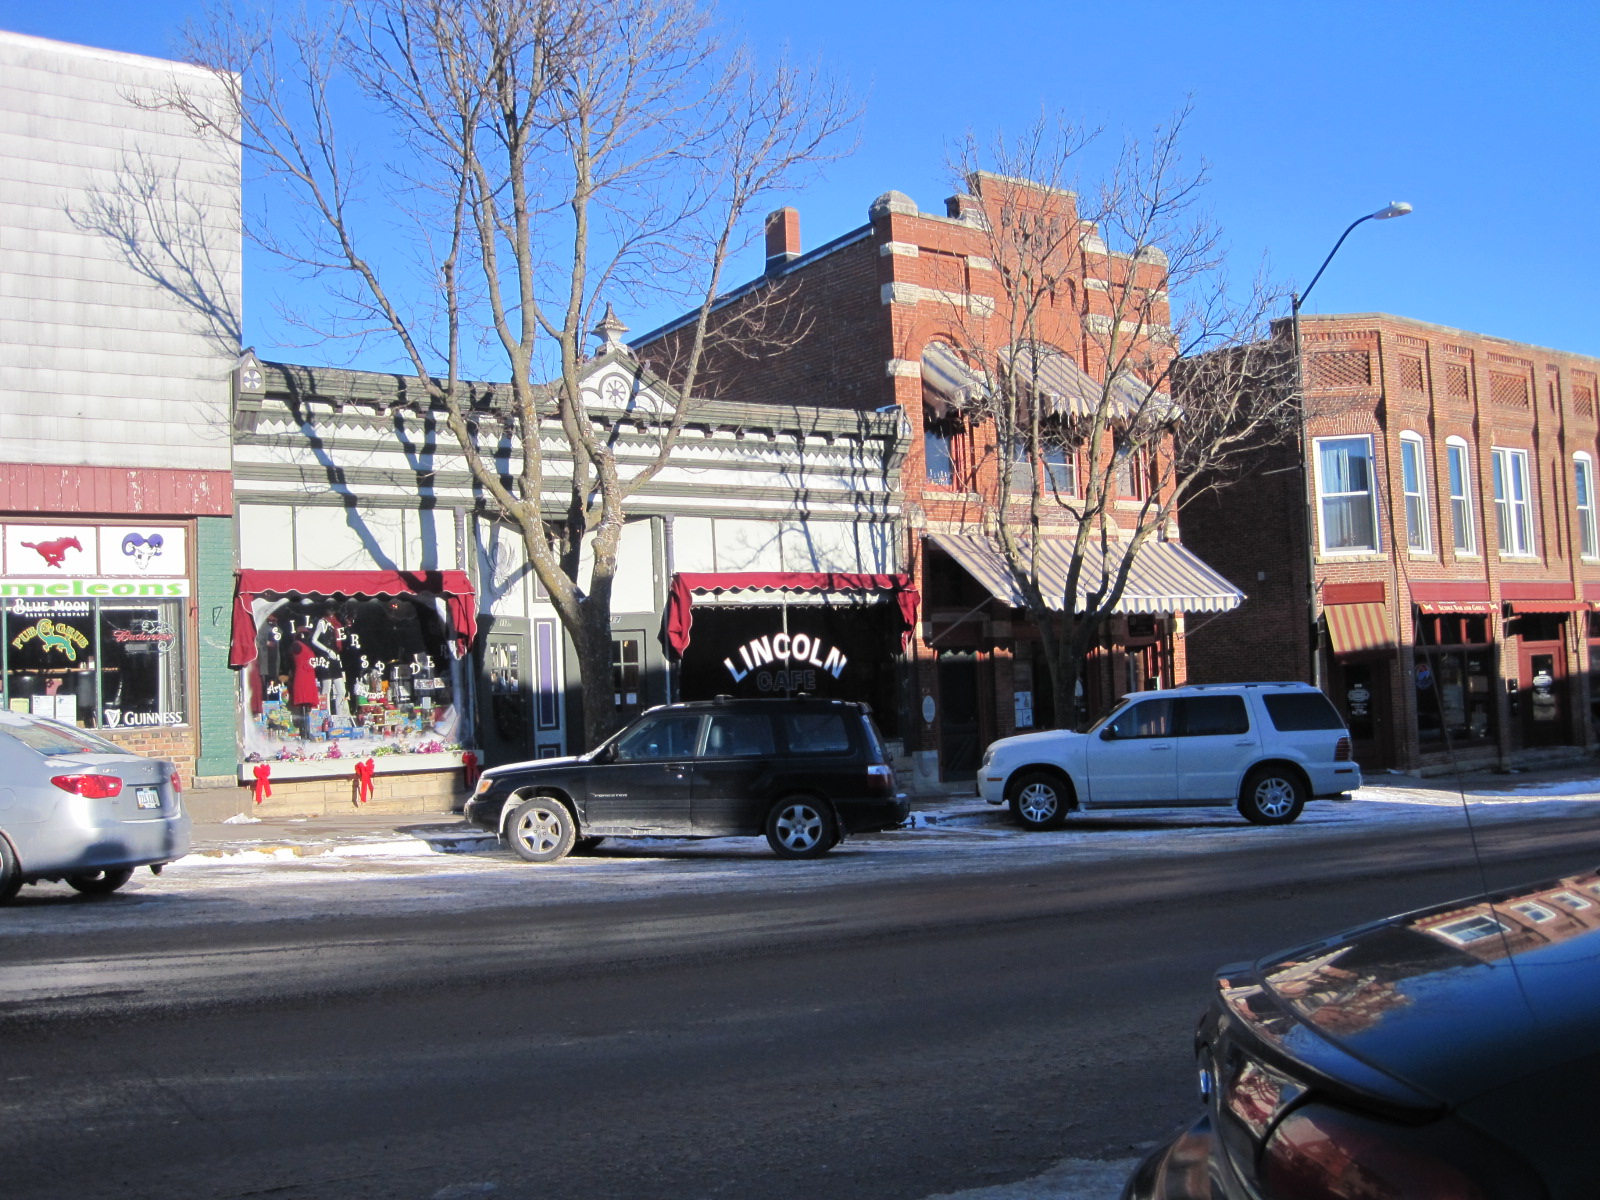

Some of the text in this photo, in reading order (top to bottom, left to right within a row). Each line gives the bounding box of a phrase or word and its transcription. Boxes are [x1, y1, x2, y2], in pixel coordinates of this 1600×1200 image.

[12, 598, 90, 614] BLUE MOON
[12, 626, 38, 650] PUB
[55, 623, 89, 649] GRUB
[272, 615, 361, 649] SILVER
[723, 633, 848, 683] LINCOLN
[757, 670, 816, 691] CAFE
[124, 711, 183, 725] GUINNESS
